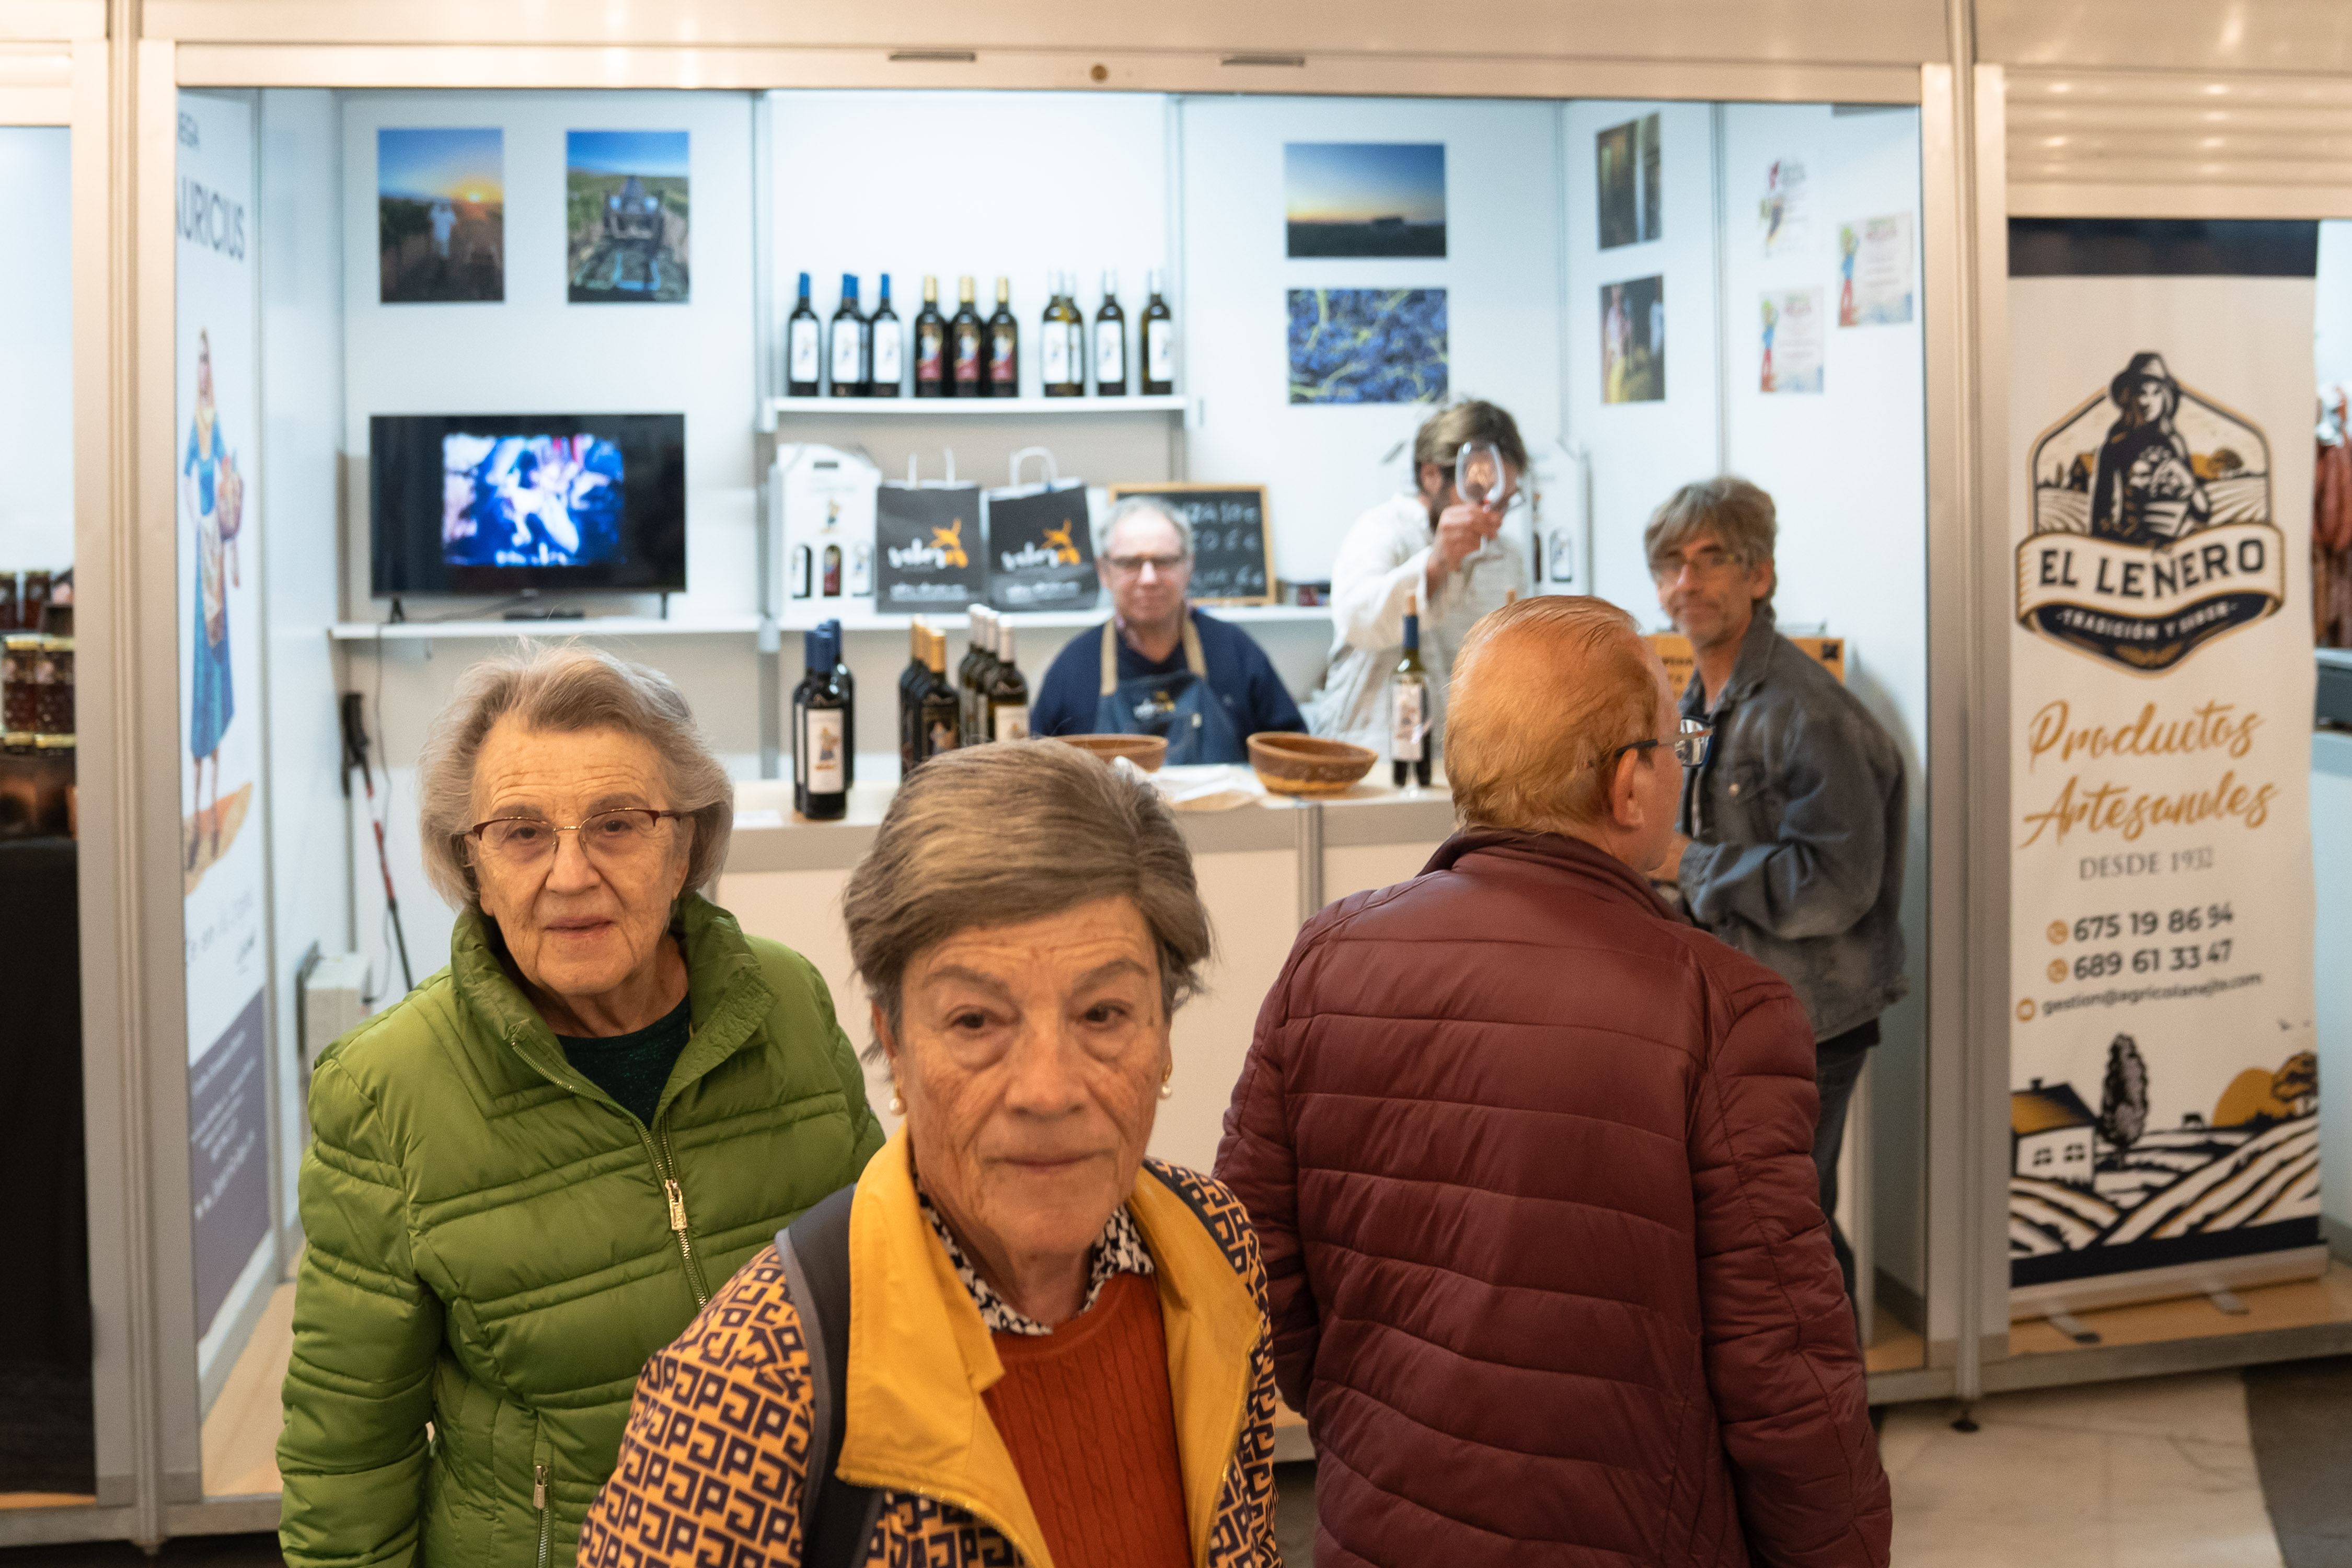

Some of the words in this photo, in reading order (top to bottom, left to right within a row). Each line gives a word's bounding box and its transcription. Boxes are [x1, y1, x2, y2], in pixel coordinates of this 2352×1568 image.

[2040, 549, 2077, 587] EL
[2029, 699, 2265, 775] Productos
[2019, 769, 2280, 850] Artesanales
[2079, 851, 2159, 880] DESDE
[2073, 913, 2121, 942] 675
[2129, 911, 2159, 936] 19
[2167, 907, 2203, 934] 86
[2073, 951, 2123, 981] 689
[2131, 948, 2160, 974] 61
[2169, 944, 2202, 971] 33
